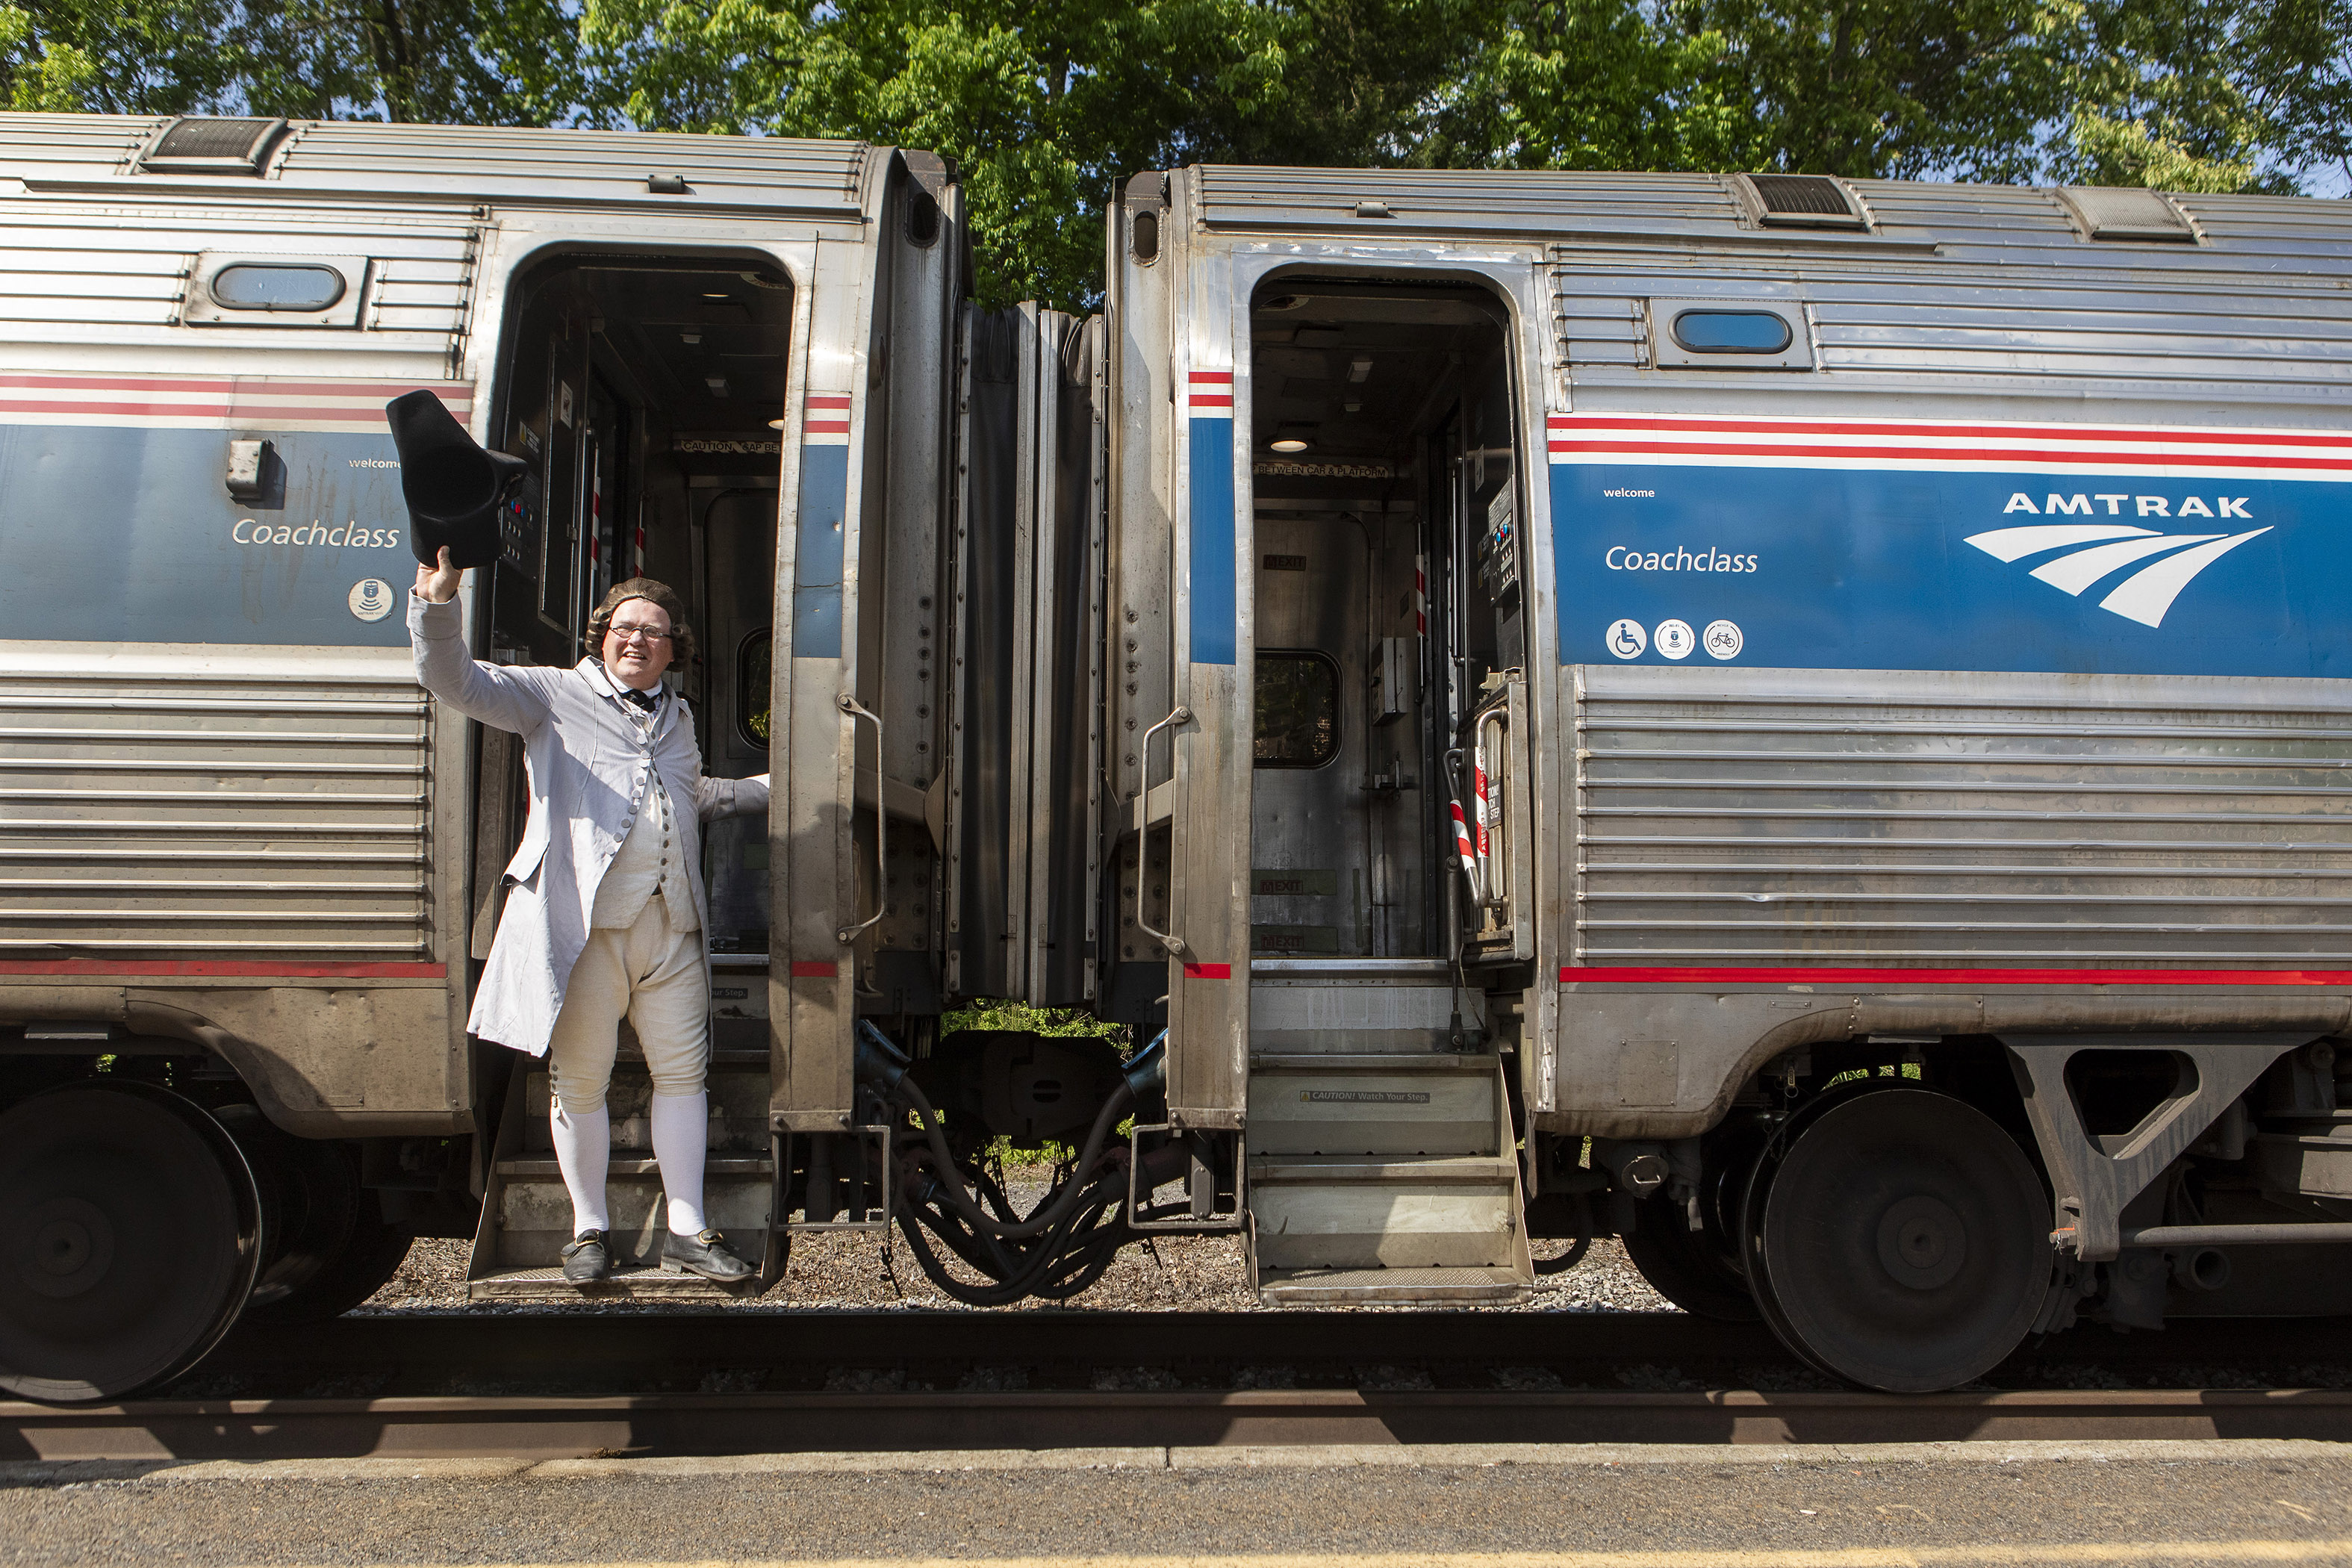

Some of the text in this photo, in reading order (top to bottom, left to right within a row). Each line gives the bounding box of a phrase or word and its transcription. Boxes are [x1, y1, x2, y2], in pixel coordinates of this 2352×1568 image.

[684, 442, 732, 451] CAUTION
[1258, 465, 1304, 474] BETWEEN
[1307, 467, 1325, 475] CAR
[1337, 467, 1386, 476] PLATFORM
[1603, 487, 1655, 498] welcome
[2003, 492, 2254, 519] AMTRAK
[231, 518, 400, 549] Coachclass
[1278, 556, 1304, 567] EXIT
[1605, 545, 1758, 573] Coachclass
[1487, 784, 1499, 799] TION!
[1275, 880, 1301, 892] EXIT
[1276, 936, 1302, 947] EXIT
[1313, 1092, 1355, 1100] CAUTION!
[1357, 1092, 1384, 1101] Watch
[1407, 1094, 1428, 1102] Step.
